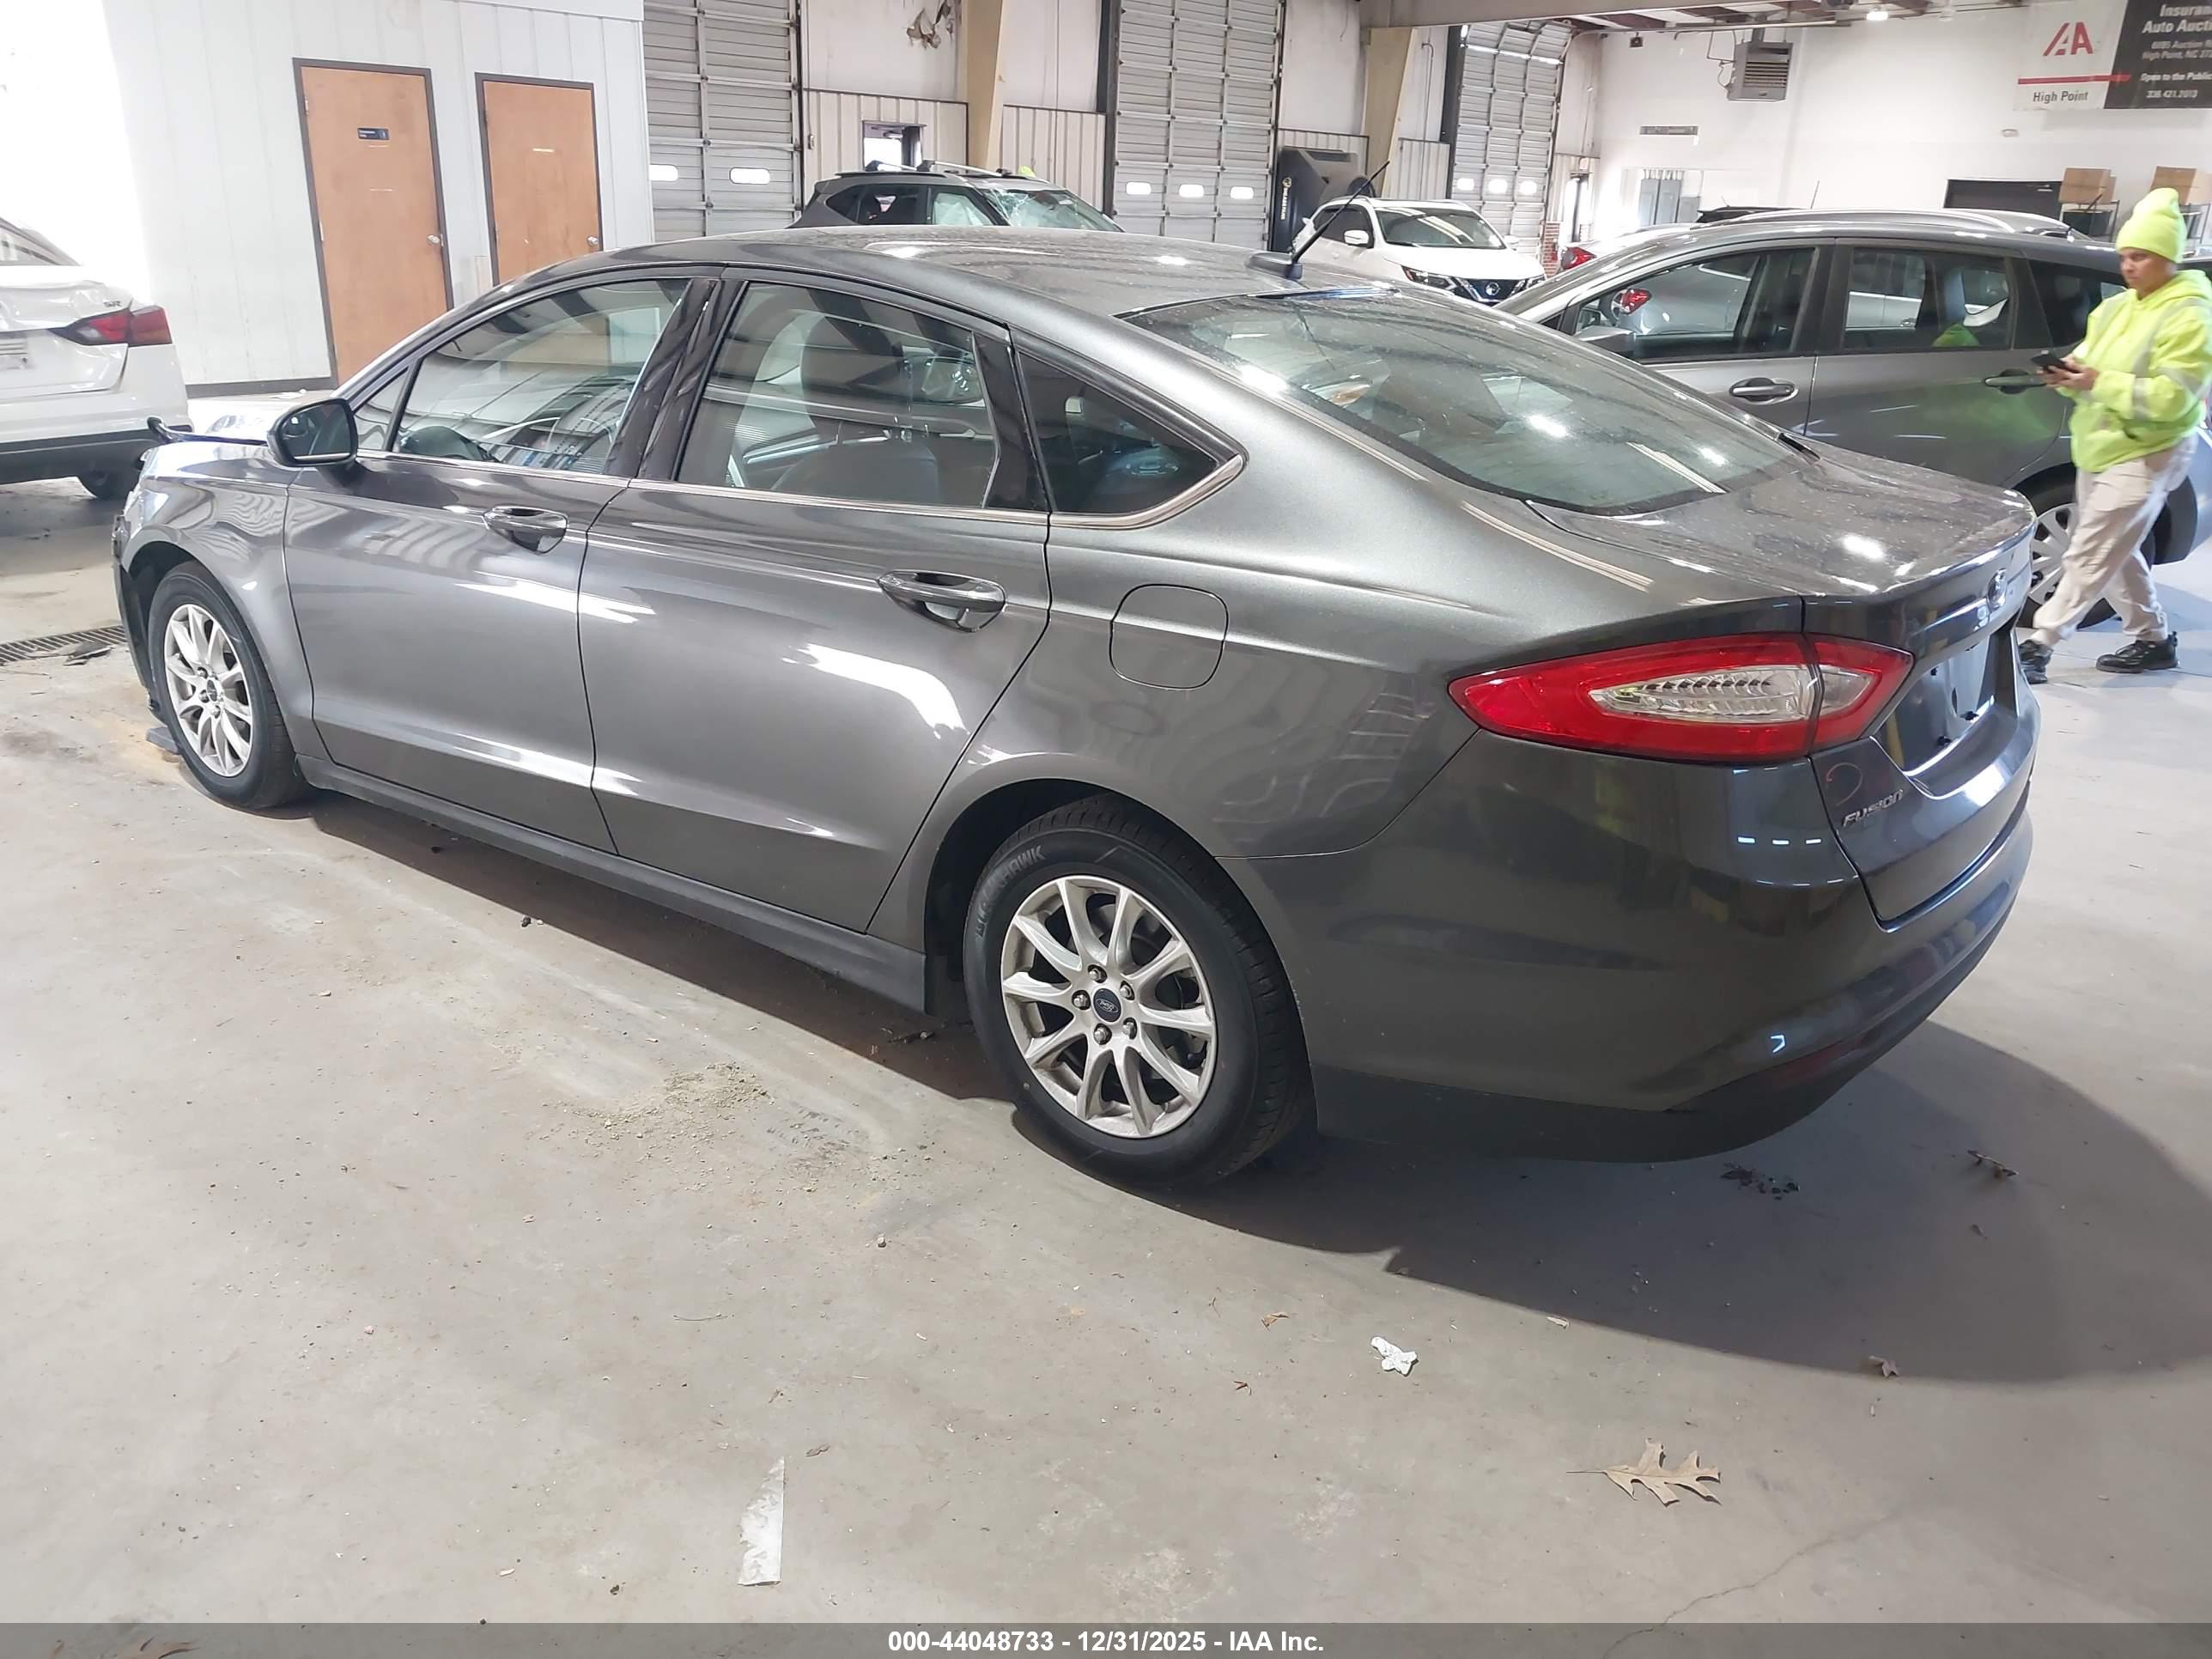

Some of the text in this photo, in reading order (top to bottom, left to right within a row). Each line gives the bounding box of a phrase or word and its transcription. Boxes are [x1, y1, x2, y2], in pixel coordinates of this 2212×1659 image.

[2142, 20, 2174, 33] Auto
[2033, 90, 2089, 104] High Point
